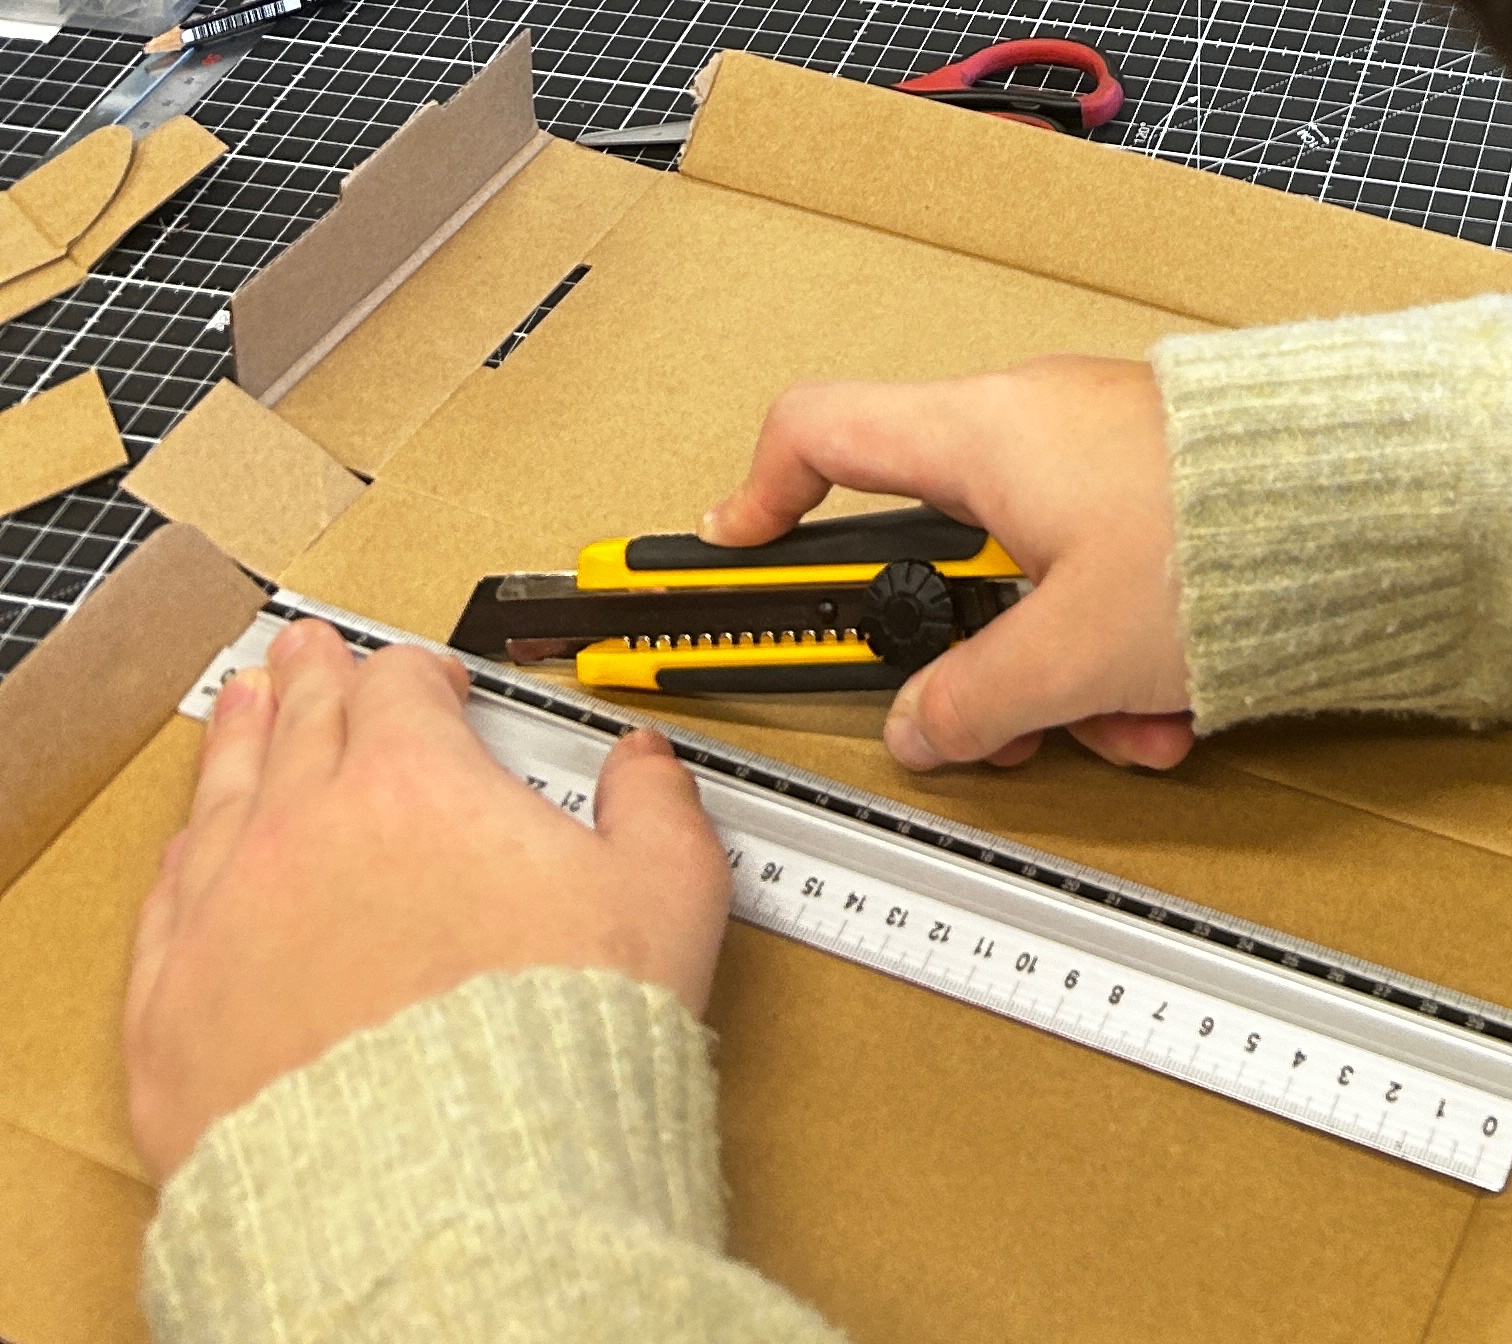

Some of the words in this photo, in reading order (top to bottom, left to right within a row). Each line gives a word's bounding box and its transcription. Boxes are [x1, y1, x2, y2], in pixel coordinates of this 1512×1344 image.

[561, 790, 587, 812] 21
[760, 862, 785, 883] 16
[802, 876, 825, 898] 15
[843, 891, 868, 913] 14
[886, 906, 909, 928] 13
[928, 920, 952, 943] 12
[973, 936, 995, 959] 11
[1016, 951, 1039, 974] 10
[1064, 969, 1080, 990] 9
[1108, 985, 1125, 1005] 8
[1152, 1001, 1169, 1022] 7
[1199, 1017, 1215, 1037] 6
[1246, 1032, 1262, 1054] 5
[1292, 1049, 1308, 1068] 4
[1337, 1065, 1355, 1086] 3
[1385, 1080, 1403, 1102] 2
[1436, 1099, 1446, 1119] 1
[1482, 1117, 1498, 1137] 0
